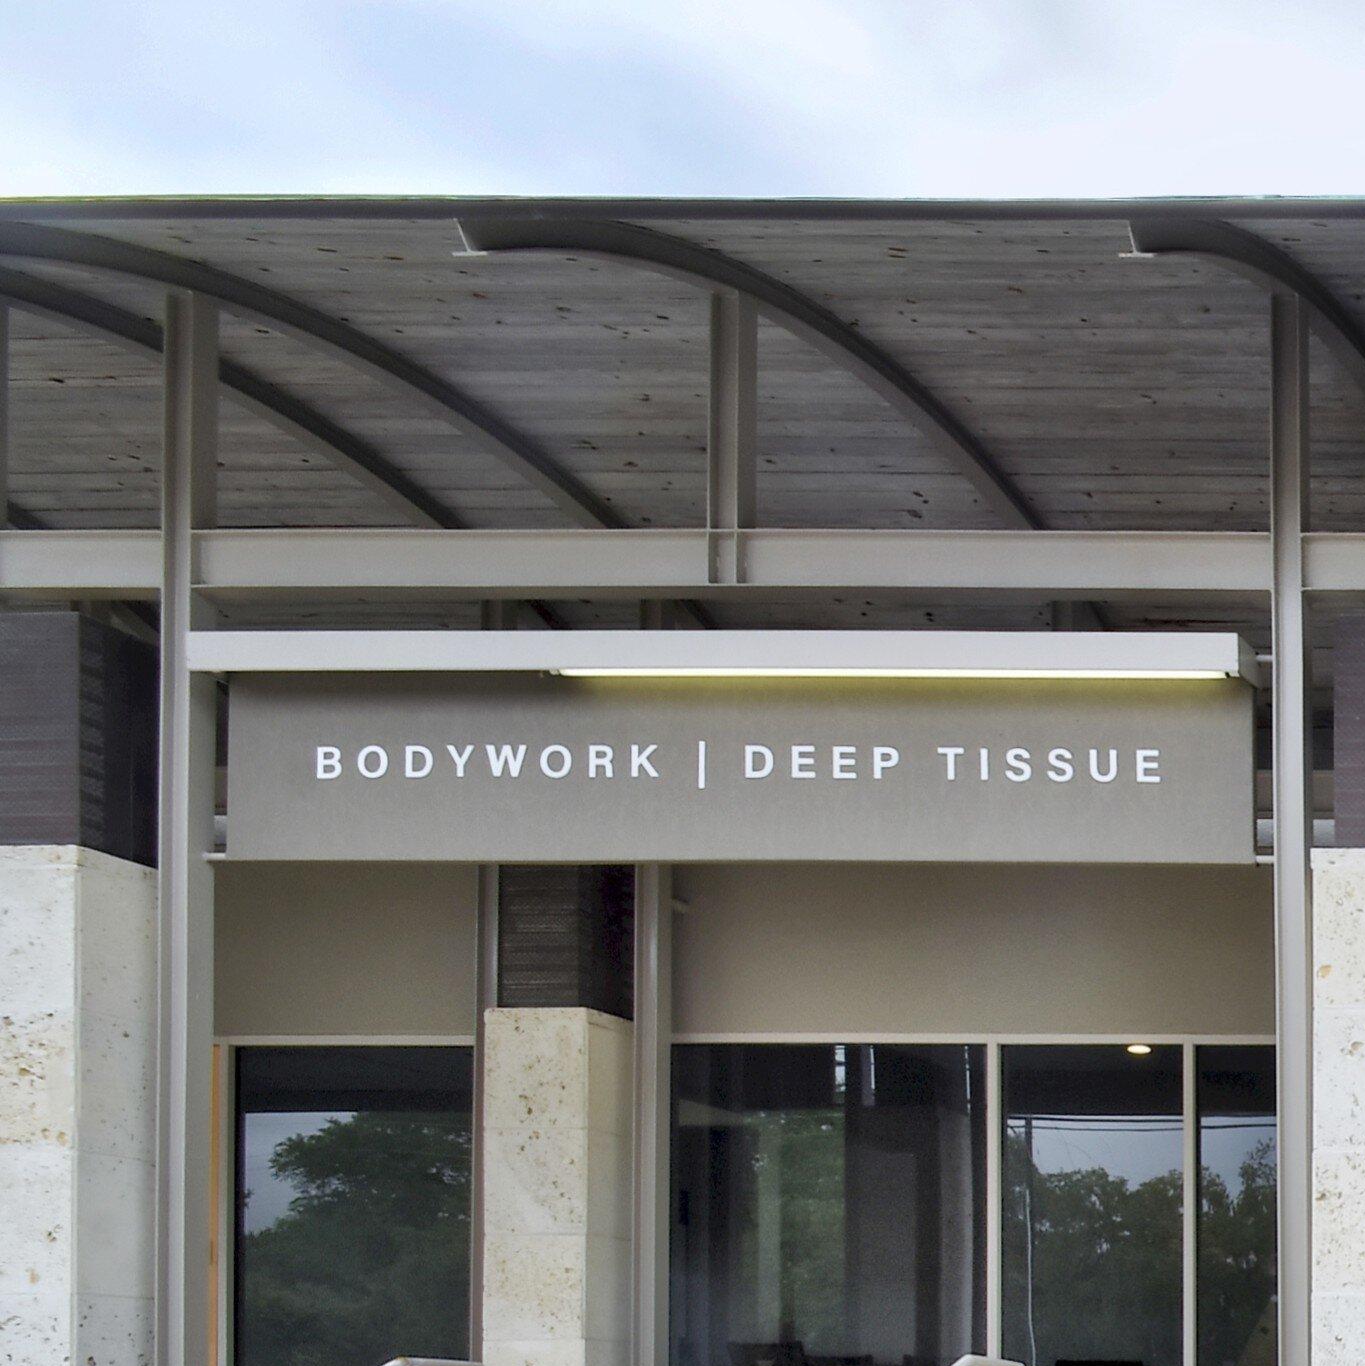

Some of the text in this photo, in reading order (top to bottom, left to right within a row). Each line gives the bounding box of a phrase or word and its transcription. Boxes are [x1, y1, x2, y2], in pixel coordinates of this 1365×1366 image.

[313, 743, 660, 781] BODYWORK
[743, 744, 900, 780] DEEP
[936, 746, 1162, 784] TISSUE
